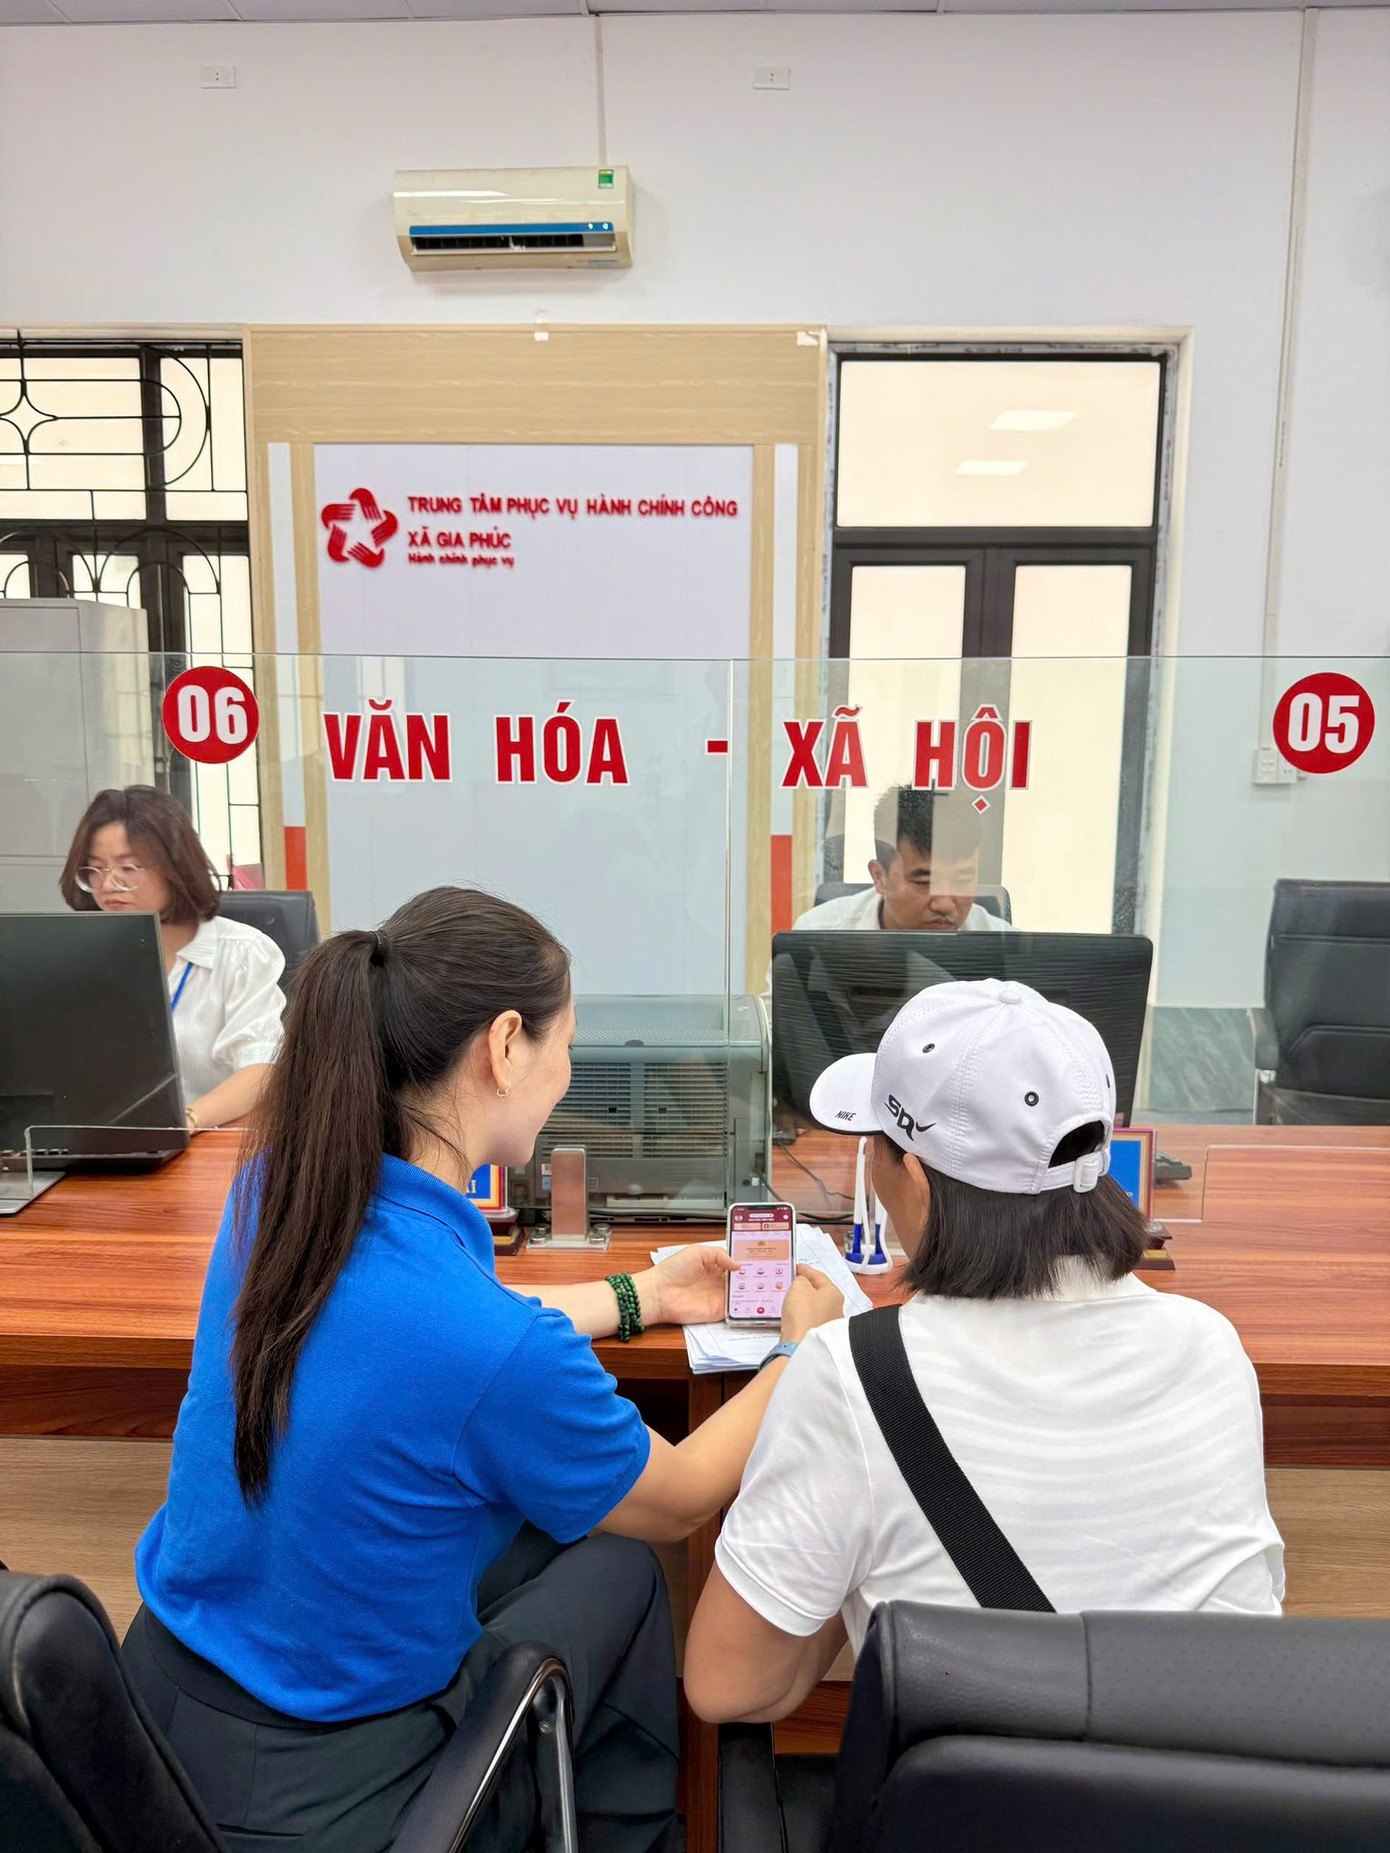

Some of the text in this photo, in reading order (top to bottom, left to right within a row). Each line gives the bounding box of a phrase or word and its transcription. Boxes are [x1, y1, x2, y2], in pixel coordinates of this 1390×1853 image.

[408, 492, 738, 520] TRUNG TÂM PHỤC VỤ HÀNH CHÍNH CÔNG
[408, 526, 431, 547] XÃ
[437, 531, 464, 547] GIA
[177, 684, 248, 744] 06
[1288, 692, 1360, 754] 05
[324, 698, 1033, 814] VĂN HÓA - XÃ HỘI
[835, 1110, 857, 1122] NIKE
